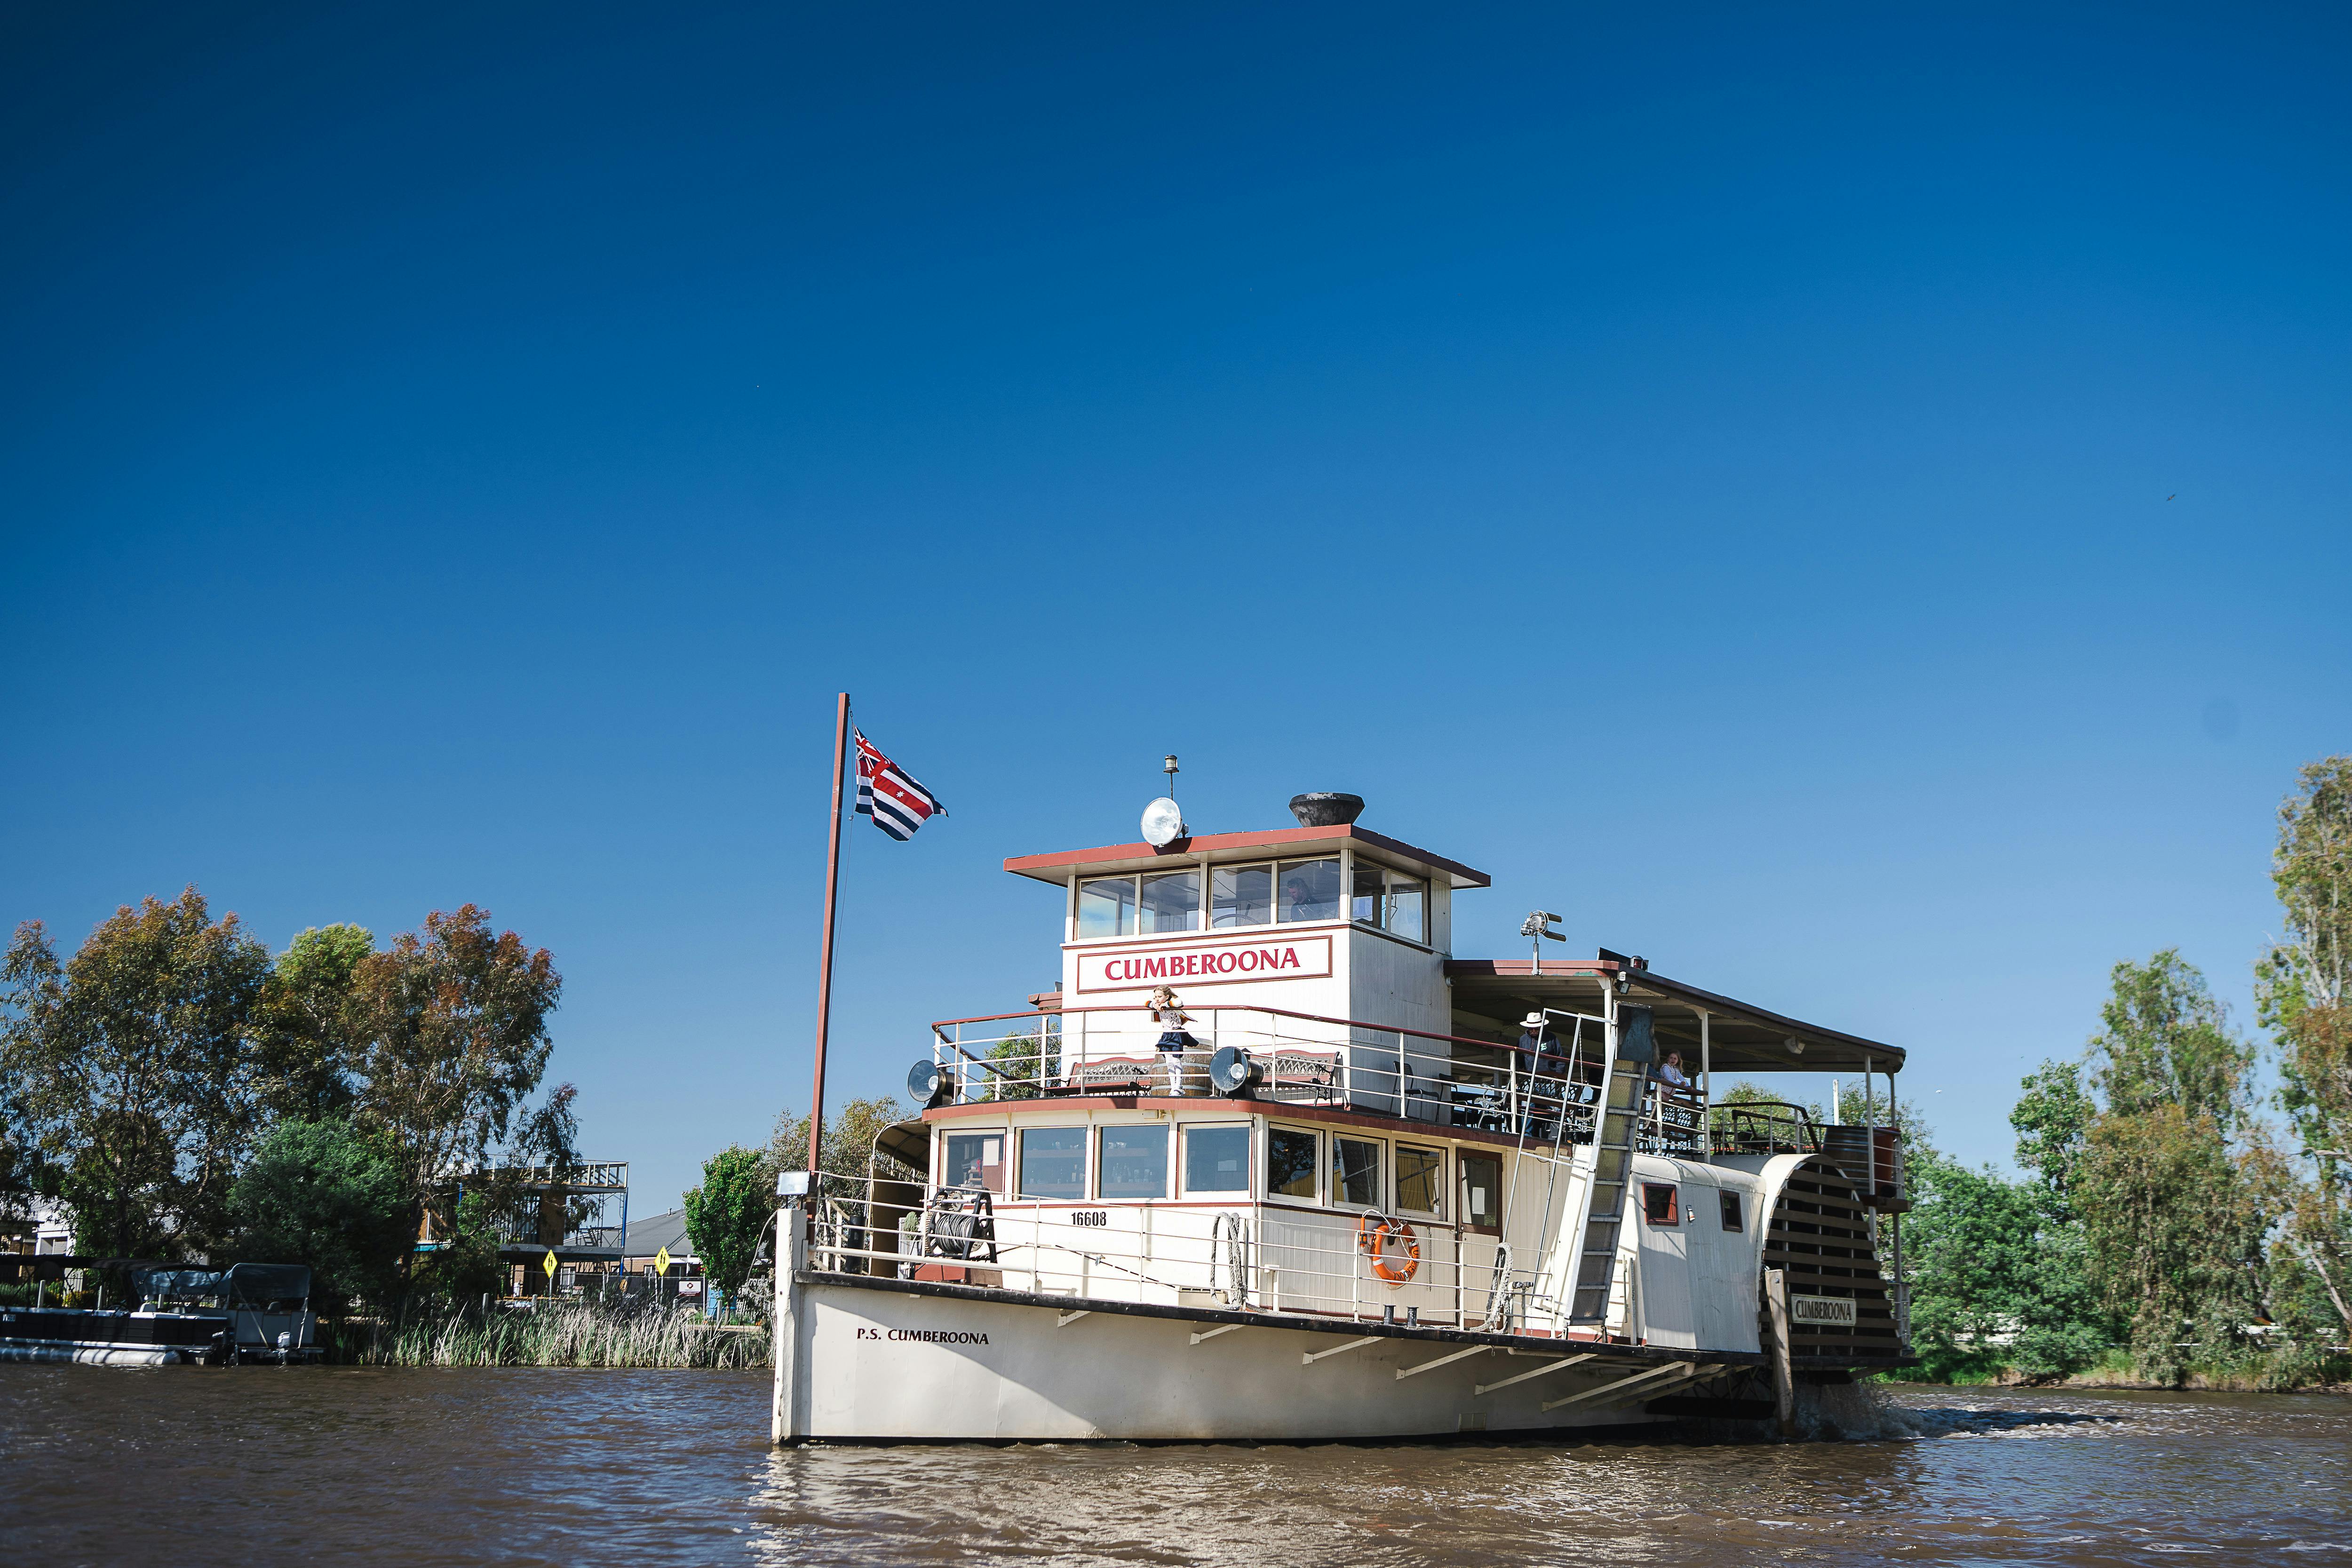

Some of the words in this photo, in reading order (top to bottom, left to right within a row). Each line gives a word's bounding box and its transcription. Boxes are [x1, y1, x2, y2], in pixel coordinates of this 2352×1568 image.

[1104, 947, 1301, 980] CUMBEROONA
[1071, 1211, 1106, 1226] 16608
[1796, 1299, 1852, 1321] CUMBEROONA
[857, 1328, 882, 1340] P.S.
[888, 1329, 989, 1345] CUMBEROONA
